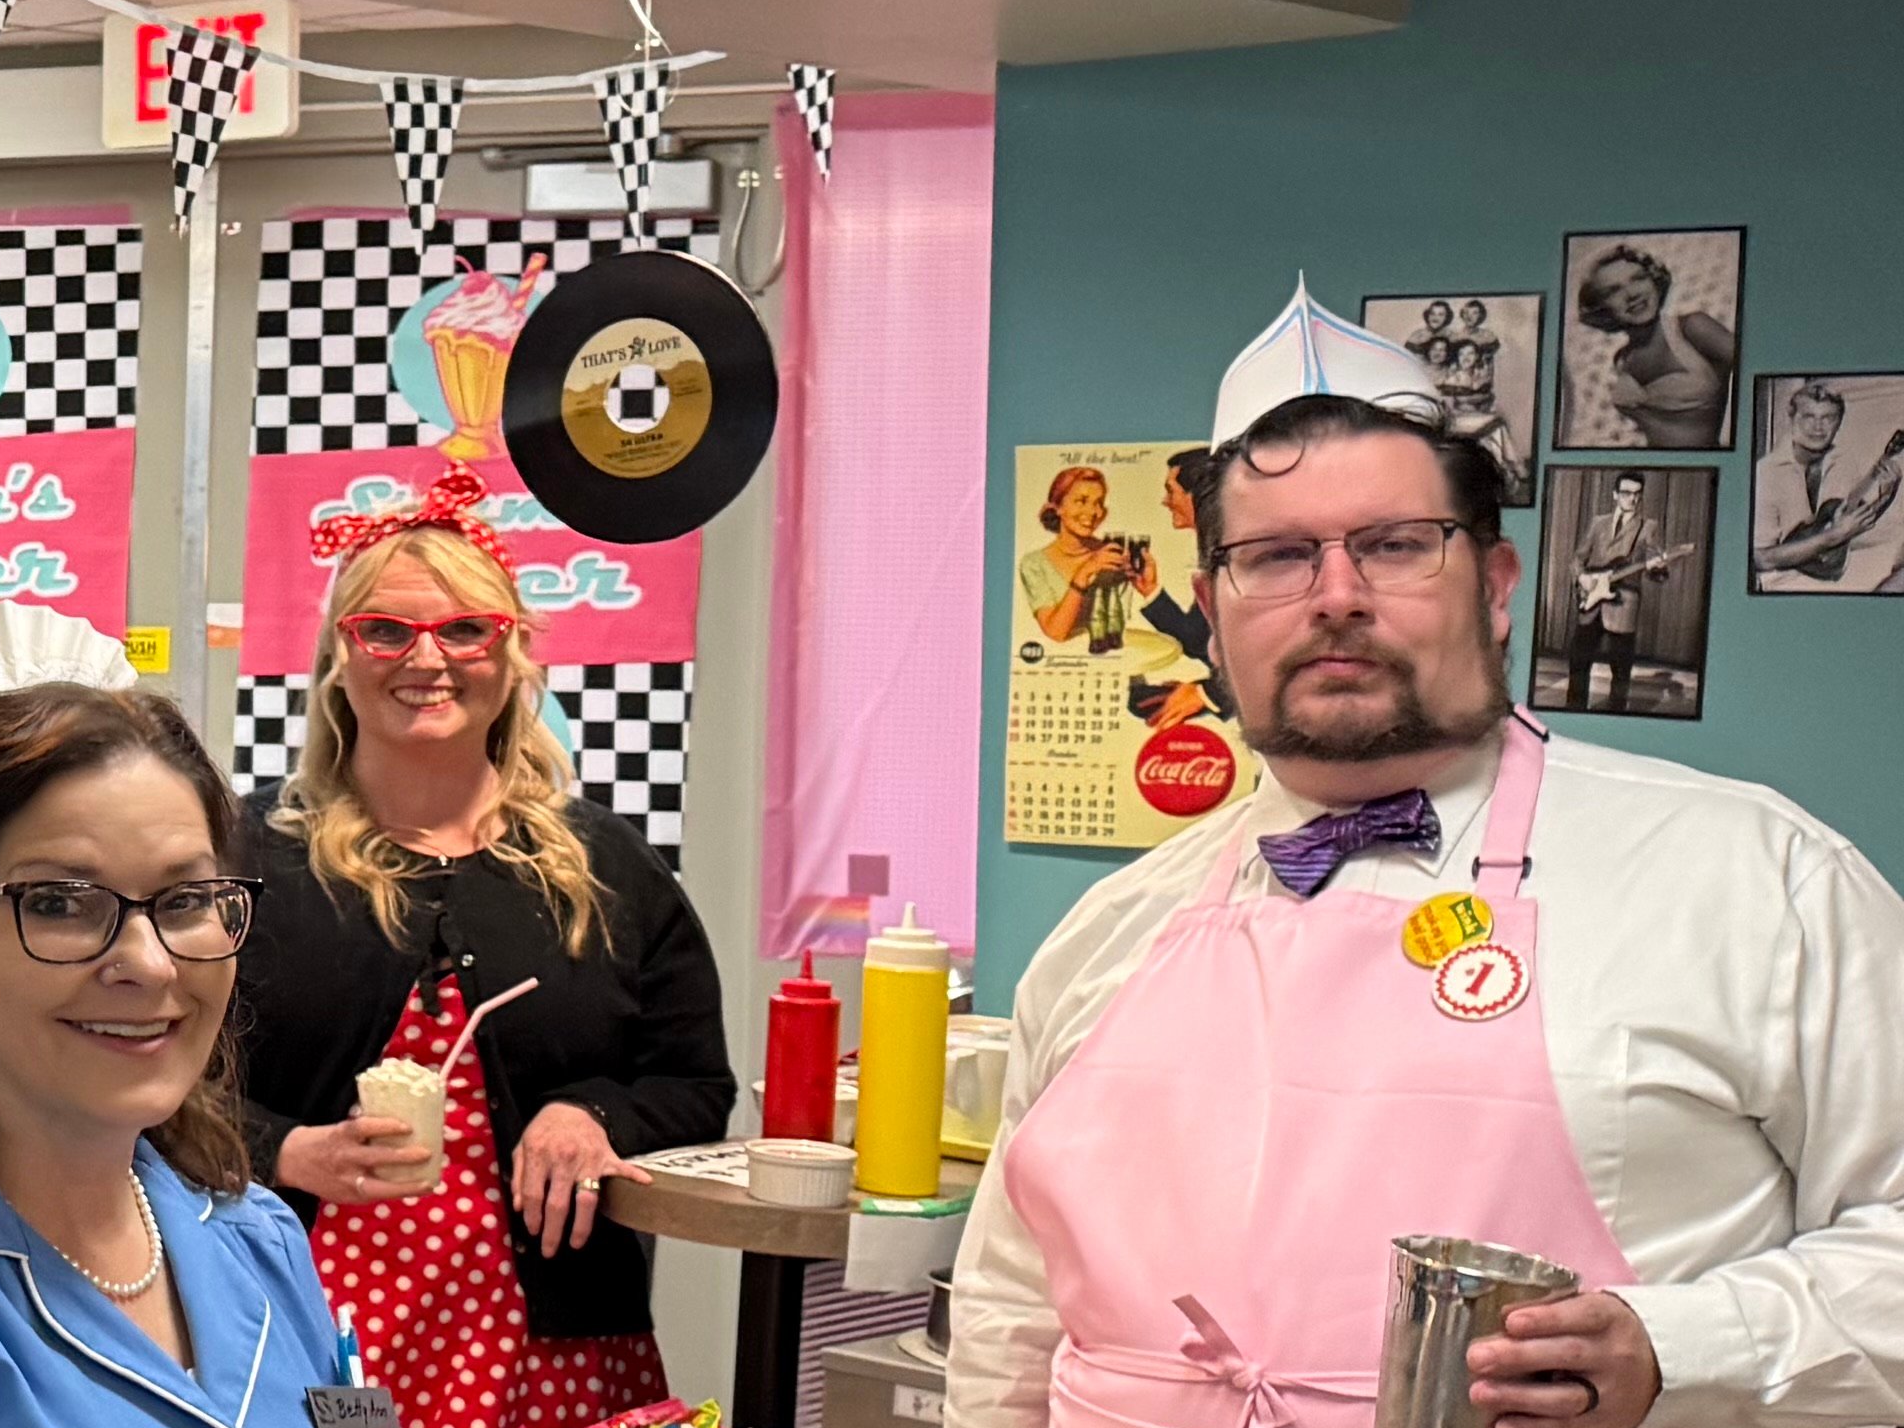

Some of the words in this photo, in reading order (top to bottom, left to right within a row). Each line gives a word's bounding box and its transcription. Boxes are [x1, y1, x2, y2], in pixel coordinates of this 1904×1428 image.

[136, 12, 266, 123] ET
[580, 347, 628, 369] THAT'S
[647, 336, 682, 355] LOVE
